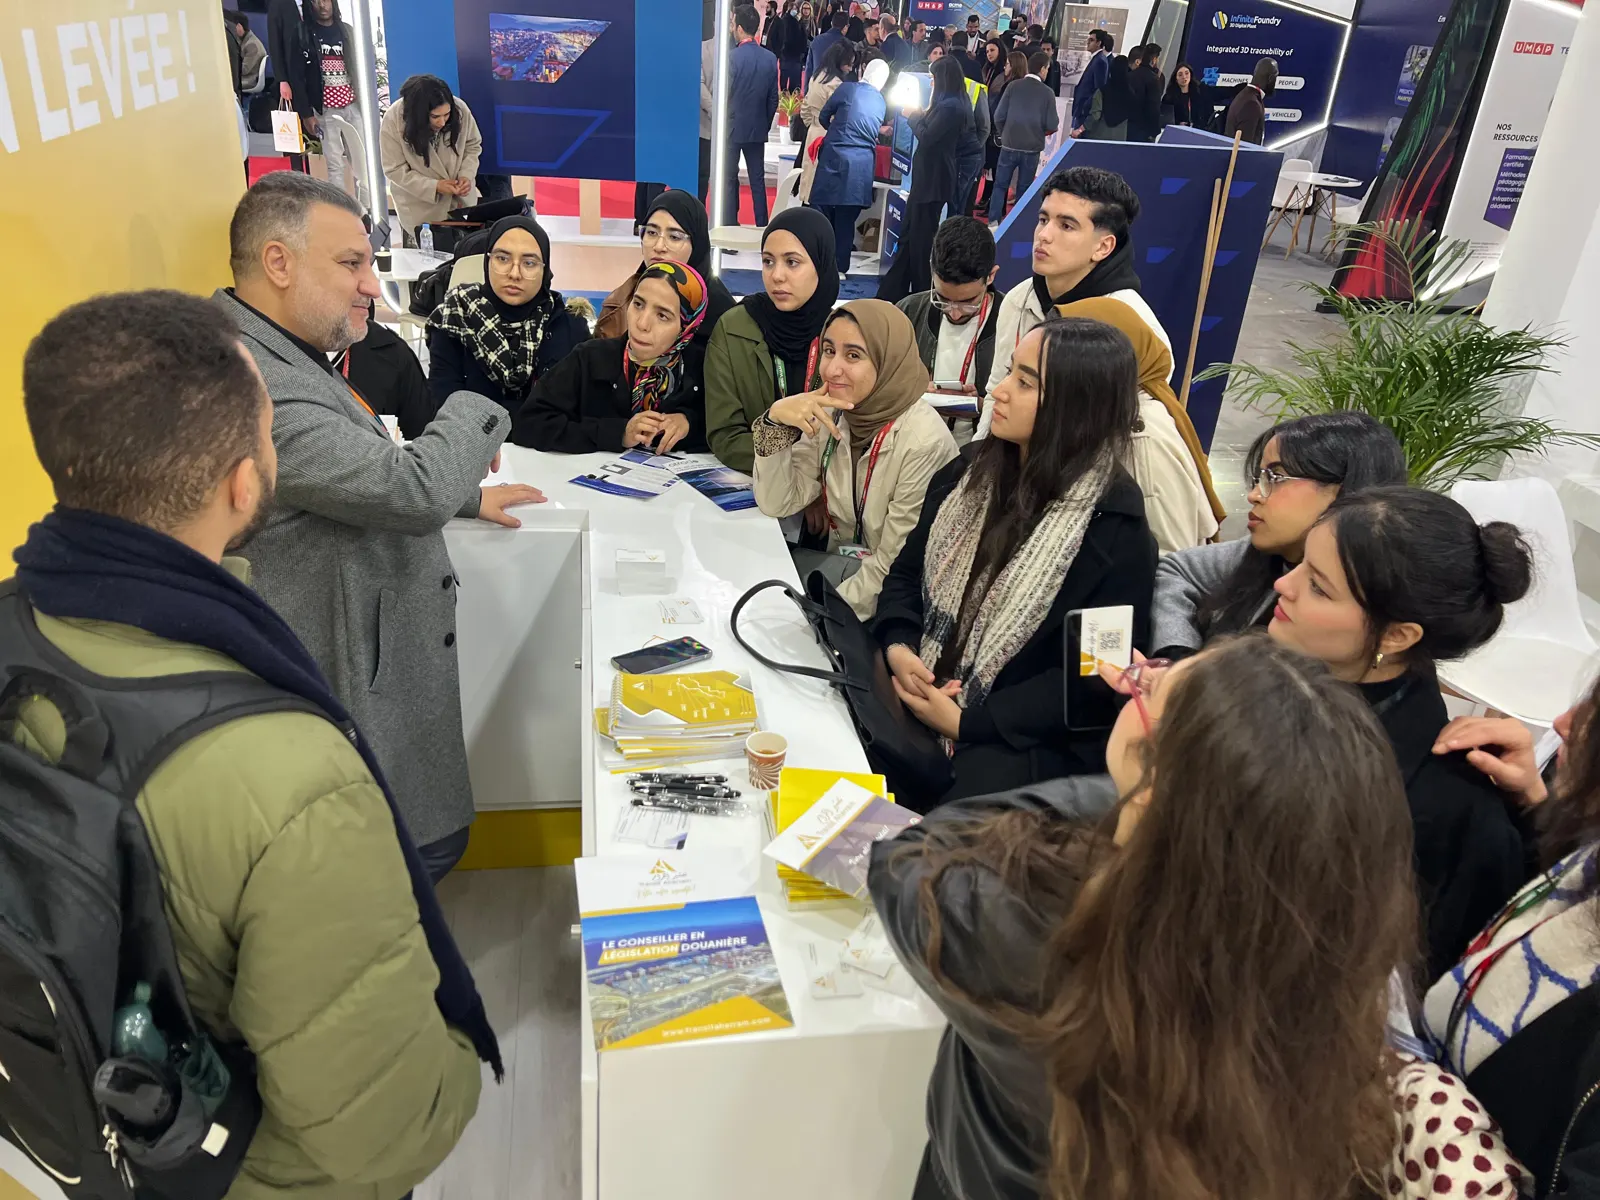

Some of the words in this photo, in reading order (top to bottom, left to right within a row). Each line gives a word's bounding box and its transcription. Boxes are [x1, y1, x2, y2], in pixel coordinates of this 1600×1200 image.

[1230, 15, 1281, 26] InfiniteFoundry
[1206, 45, 1240, 54] Integrated
[1240, 46, 1250, 54] 3D
[1250, 47, 1285, 57] traceability
[1285, 48, 1294, 56] of
[1514, 42, 1553, 55] UM6P
[1496, 123, 1512, 131] NOS
[1493, 133, 1539, 143] RESSOURCES
[602, 940, 616, 949] LE
[618, 932, 688, 947] CONSEILLER
[690, 930, 705, 940] EN
[603, 944, 679, 961] LÉGISLATION
[681, 936, 748, 952] DOUANIÈRE
